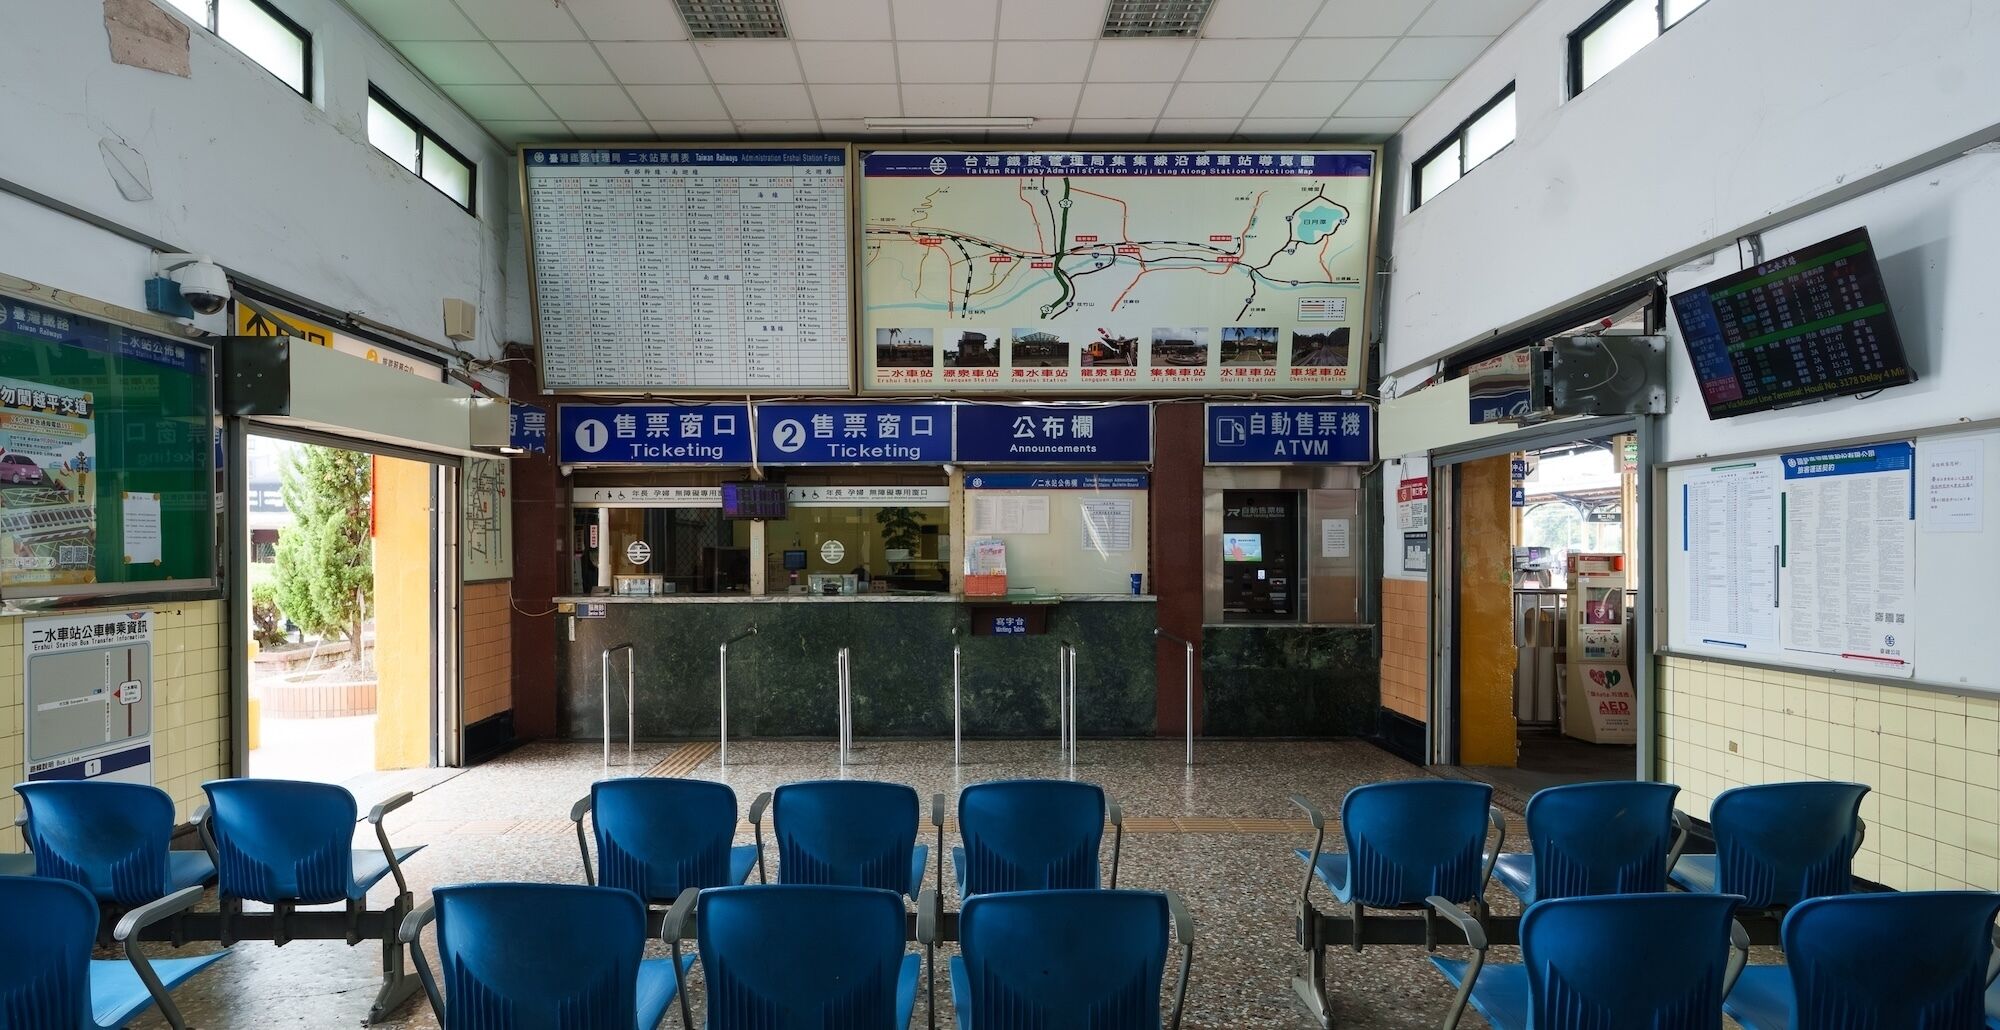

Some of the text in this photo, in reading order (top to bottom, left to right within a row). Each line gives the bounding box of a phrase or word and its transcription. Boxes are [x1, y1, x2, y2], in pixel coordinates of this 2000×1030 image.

[549, 152, 690, 163] 臺灣鐵路管理局 二水站票價表
[695, 153, 714, 162] Taiwan
[716, 153, 738, 163] Railways
[742, 153, 782, 162] Administration
[802, 153, 822, 162] Station
[824, 153, 840, 162] Fares
[964, 155, 1315, 167] 台灣鐵路管理局集集線沿線車站導覽圖
[1004, 168, 1044, 176] Railway
[1298, 168, 1314, 176] Map
[16, 322, 62, 340] Taiwan Railways
[1823, 333, 1843, 343] 13:47
[877, 368, 1346, 377] 二水車站 源泉車站 濁水車站 龍泉車站 集集車站 水里車站 車埕車站
[1838, 375, 1859, 386] 3178
[1859, 371, 1883, 385] Delay
[0, 386, 88, 415] 勿闖越平交道
[614, 412, 736, 438] 售票窗口
[811, 413, 933, 439] 售票窗口
[1012, 415, 1094, 439] 公布欄
[1250, 412, 1360, 436] 自動售票機
[584, 423, 595, 447] 1
[782, 424, 798, 446] 2
[630, 444, 723, 460] Ticketing
[827, 444, 920, 460] Ticketing
[1010, 444, 1097, 452] Announcements
[1274, 440, 1328, 456] ATVM
[1242, 506, 1284, 514] 自動售票機
[32, 620, 148, 644] 二水車站公車轉乘資訊
[1600, 701, 1628, 710] AED
[68, 756, 80, 764] Line
